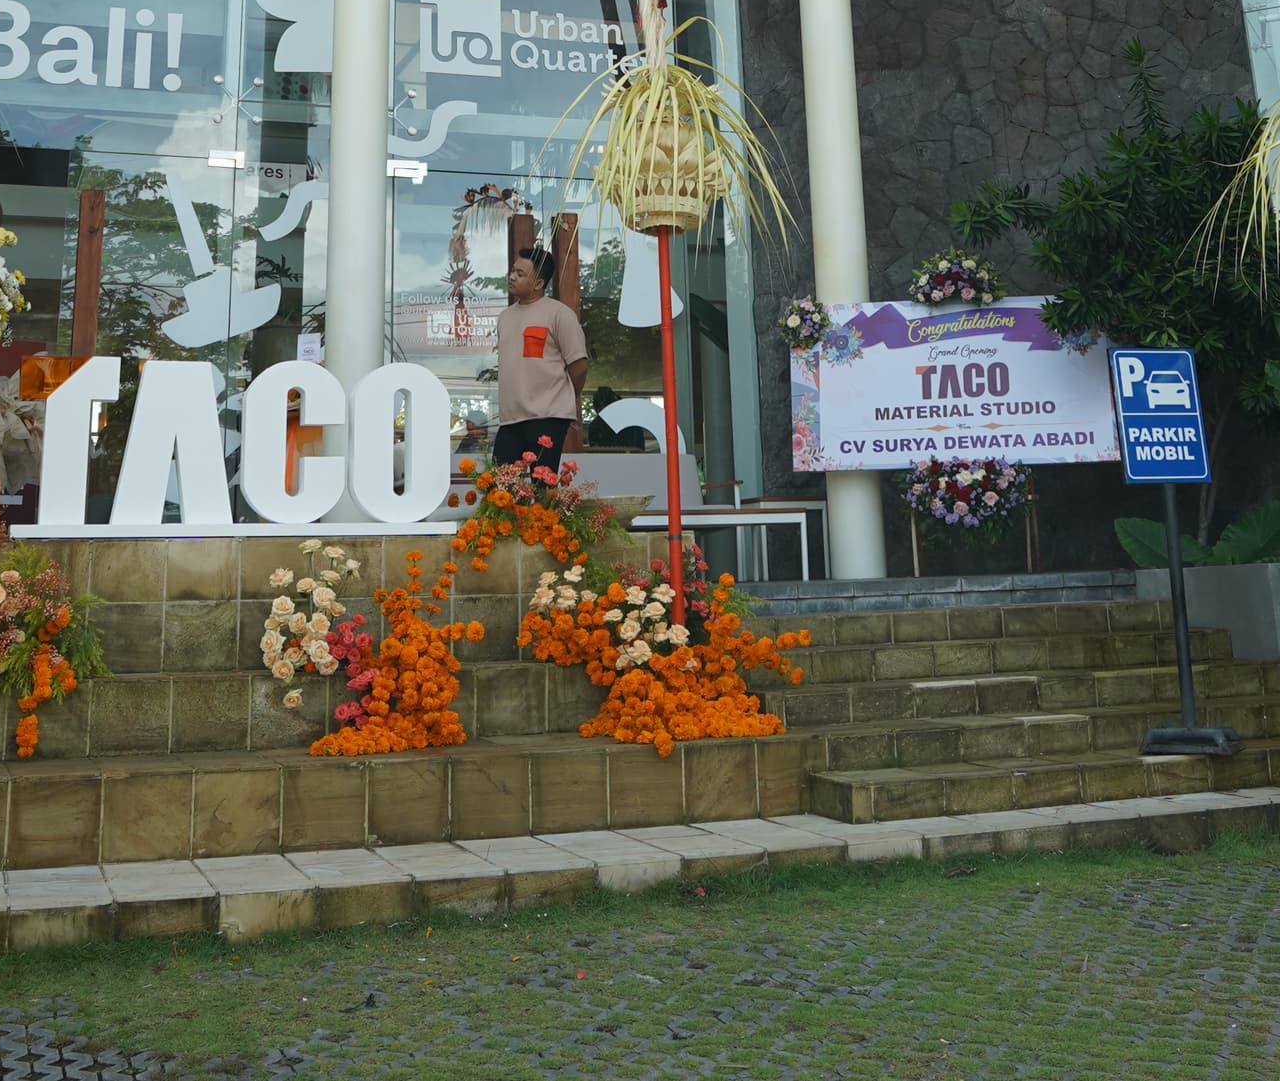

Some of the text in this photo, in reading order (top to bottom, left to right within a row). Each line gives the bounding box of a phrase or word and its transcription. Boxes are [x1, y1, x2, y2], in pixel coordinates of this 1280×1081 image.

[511, 8, 624, 45] Urban
[400, 293, 489, 305] Follow us now
[906, 311, 1016, 343] Congratulations
[928, 345, 960, 362] Grand
[915, 361, 1010, 400] TACO
[1118, 357, 1145, 397] P
[874, 400, 1056, 421] MATERIAL STUDIO
[20, 356, 451, 525] TACO
[839, 431, 1095, 454] CV SURYA DEWATA ABADI
[1128, 427, 1197, 442] PARKIR
[1135, 446, 1195, 461] MOBIL
